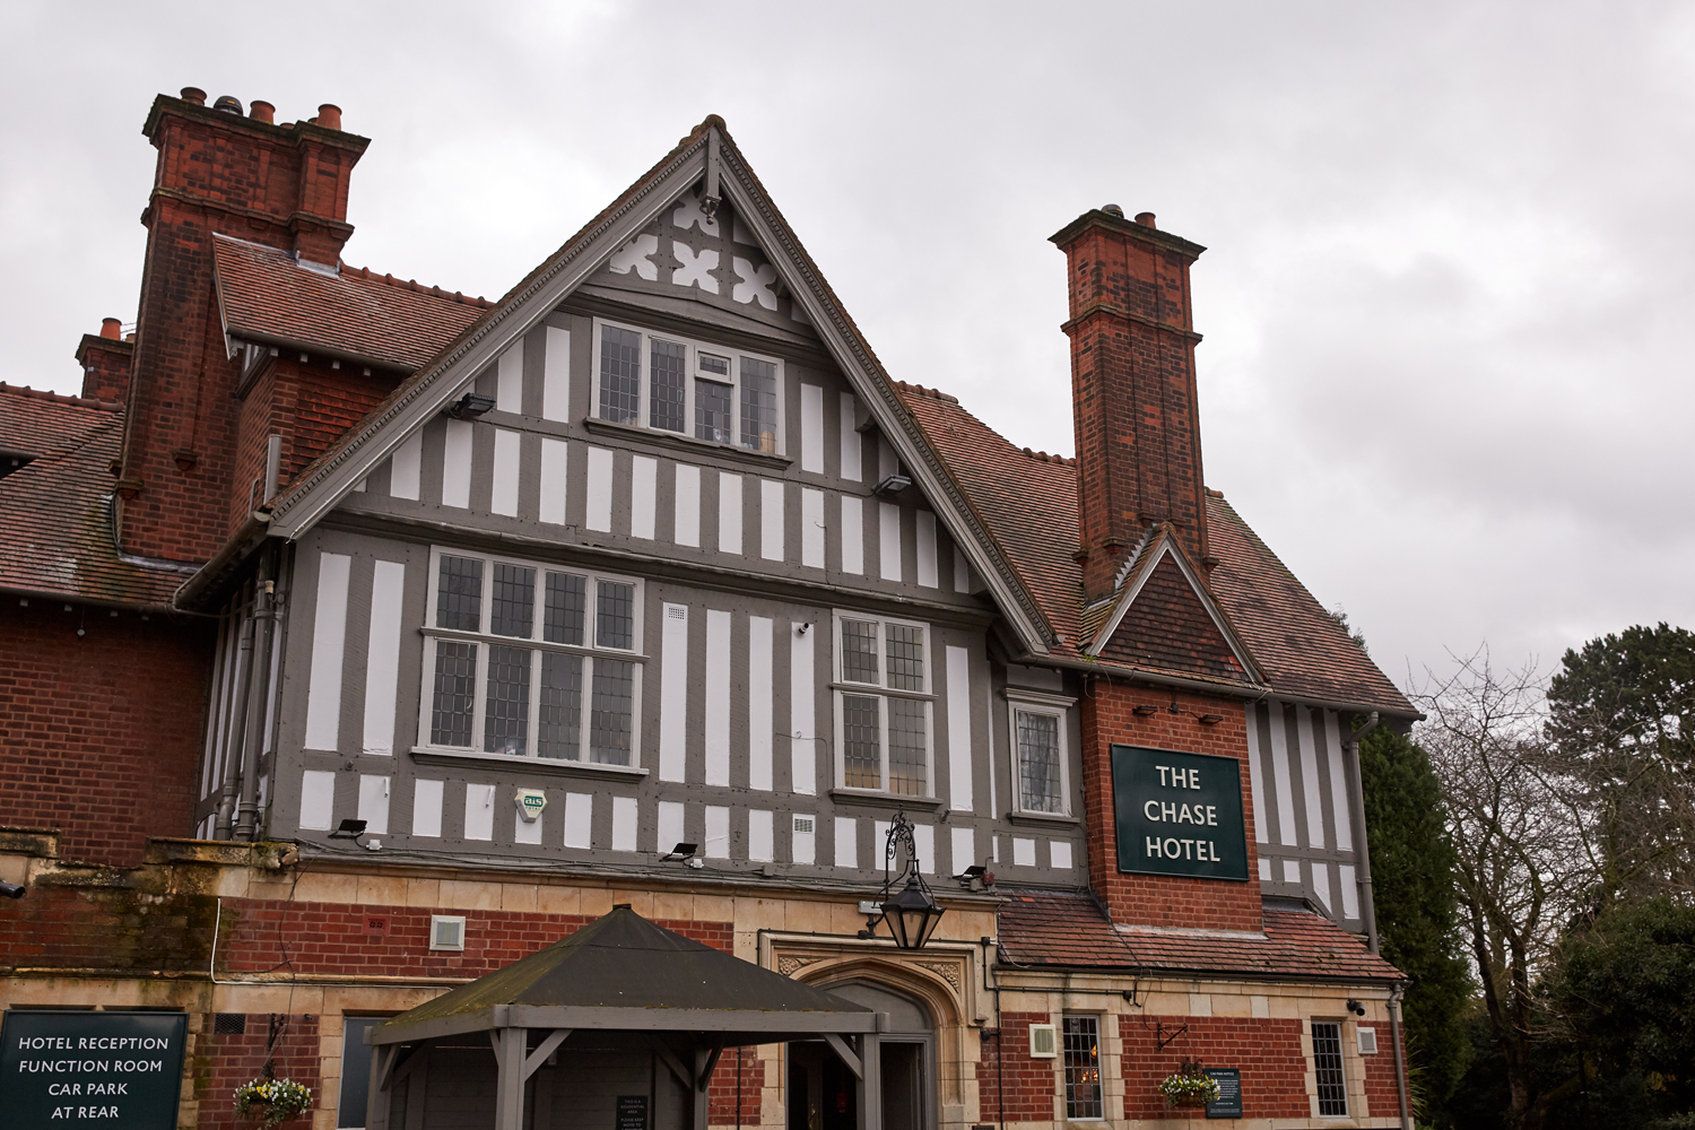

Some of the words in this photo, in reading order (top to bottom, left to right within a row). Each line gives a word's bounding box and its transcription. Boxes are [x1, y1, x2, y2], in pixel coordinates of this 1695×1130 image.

[1156, 766, 1200, 789] THE
[1144, 801, 1217, 826] CHASE
[1146, 837, 1220, 861] HOTEL
[19, 1038, 72, 1049] HOTEL
[79, 1038, 168, 1049] RECEPTION
[20, 1061, 108, 1072] FUNCTION
[114, 1061, 162, 1072] ROOM
[49, 1084, 81, 1095] CAR
[87, 1083, 127, 1095] PARK
[52, 1107, 73, 1119] AT
[78, 1106, 118, 1118] REAR
